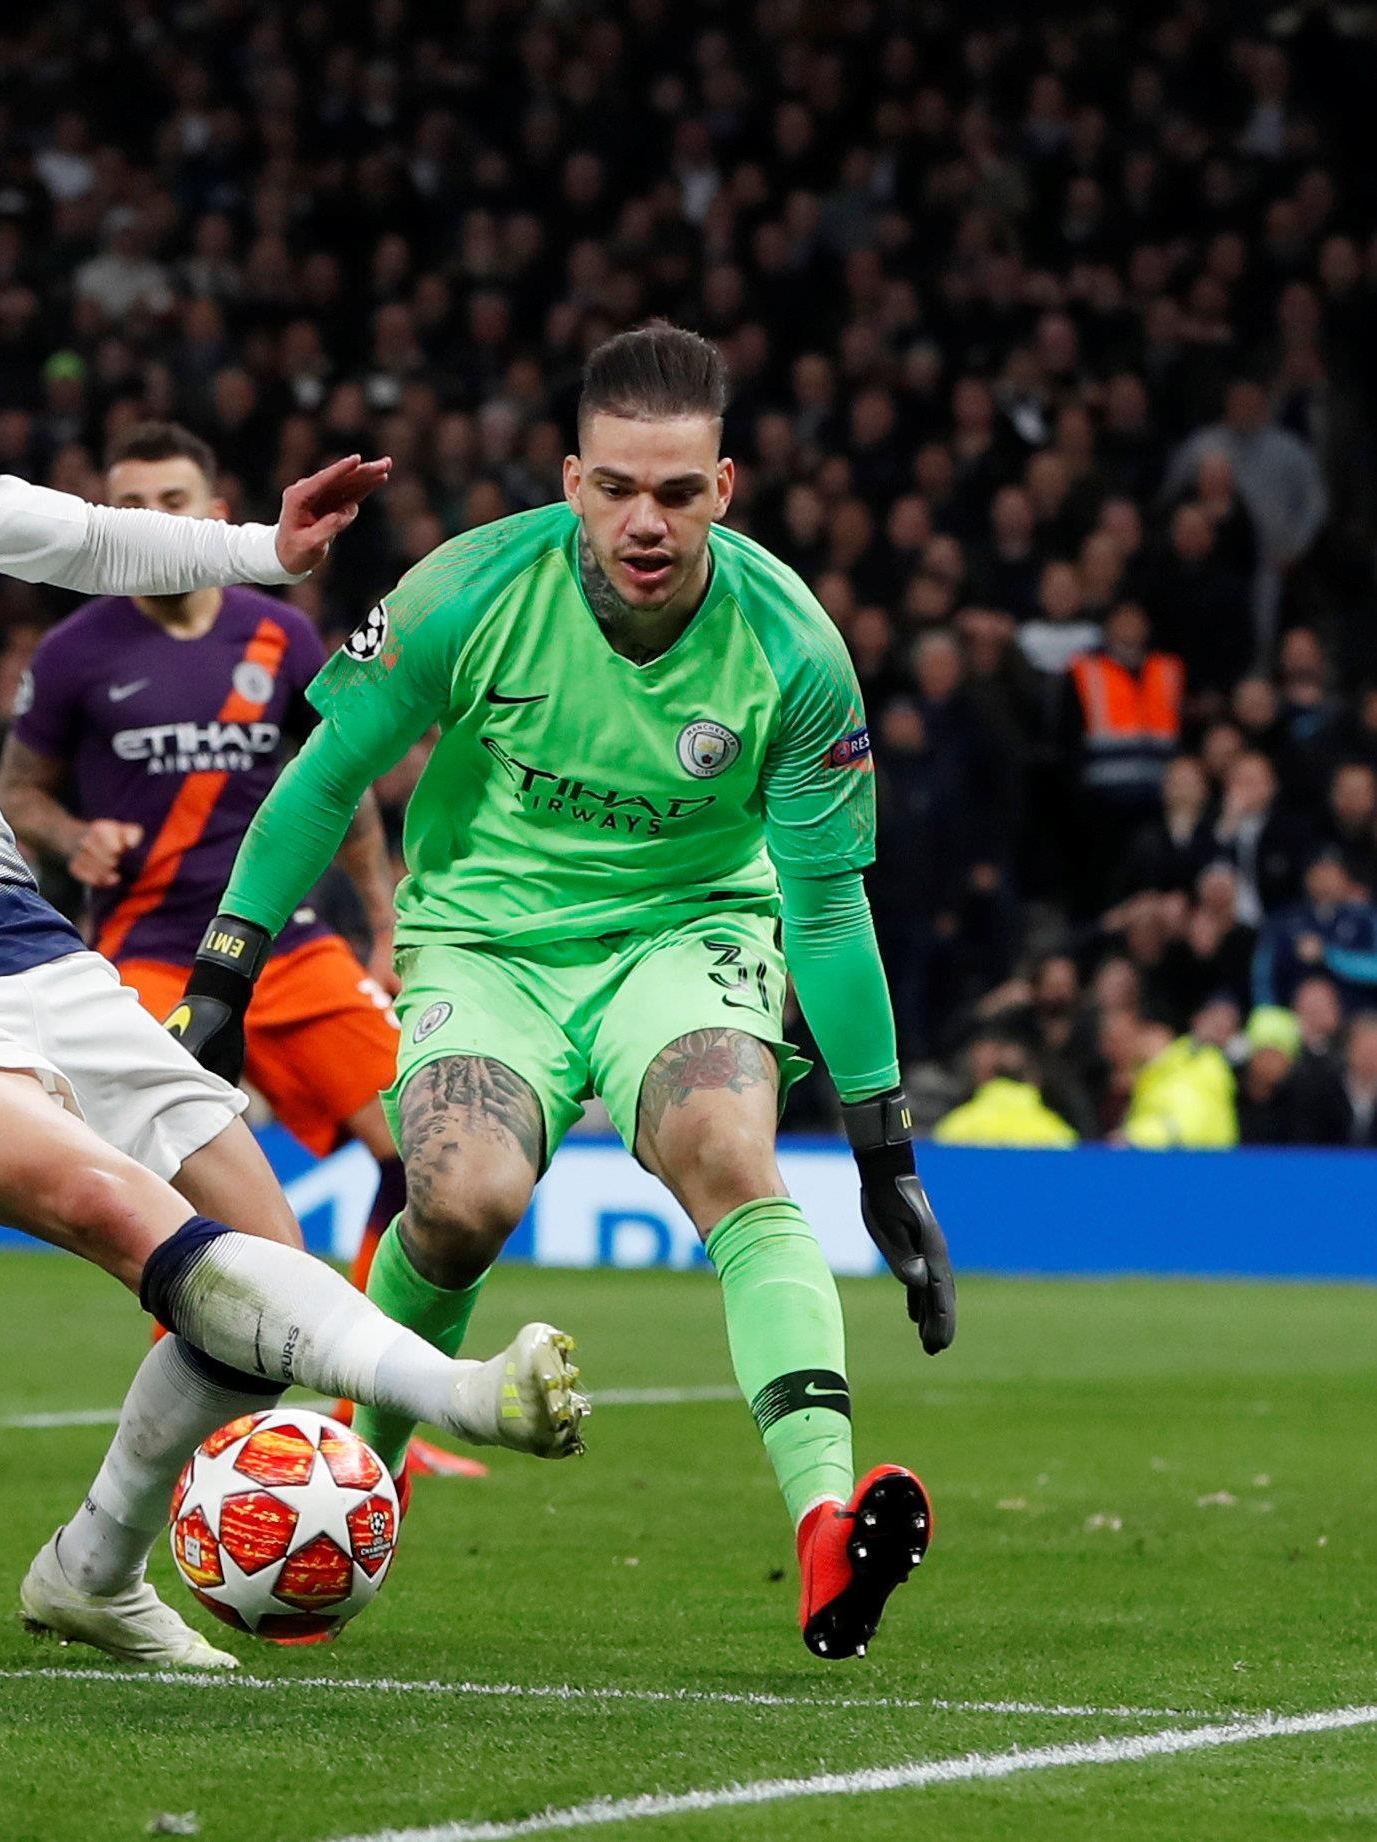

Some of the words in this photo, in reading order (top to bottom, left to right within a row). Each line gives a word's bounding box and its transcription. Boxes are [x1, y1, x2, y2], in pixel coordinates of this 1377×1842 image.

[112, 721, 280, 761] ETIHAD
[851, 733, 870, 753] RES
[703, 940, 769, 1013] 31
